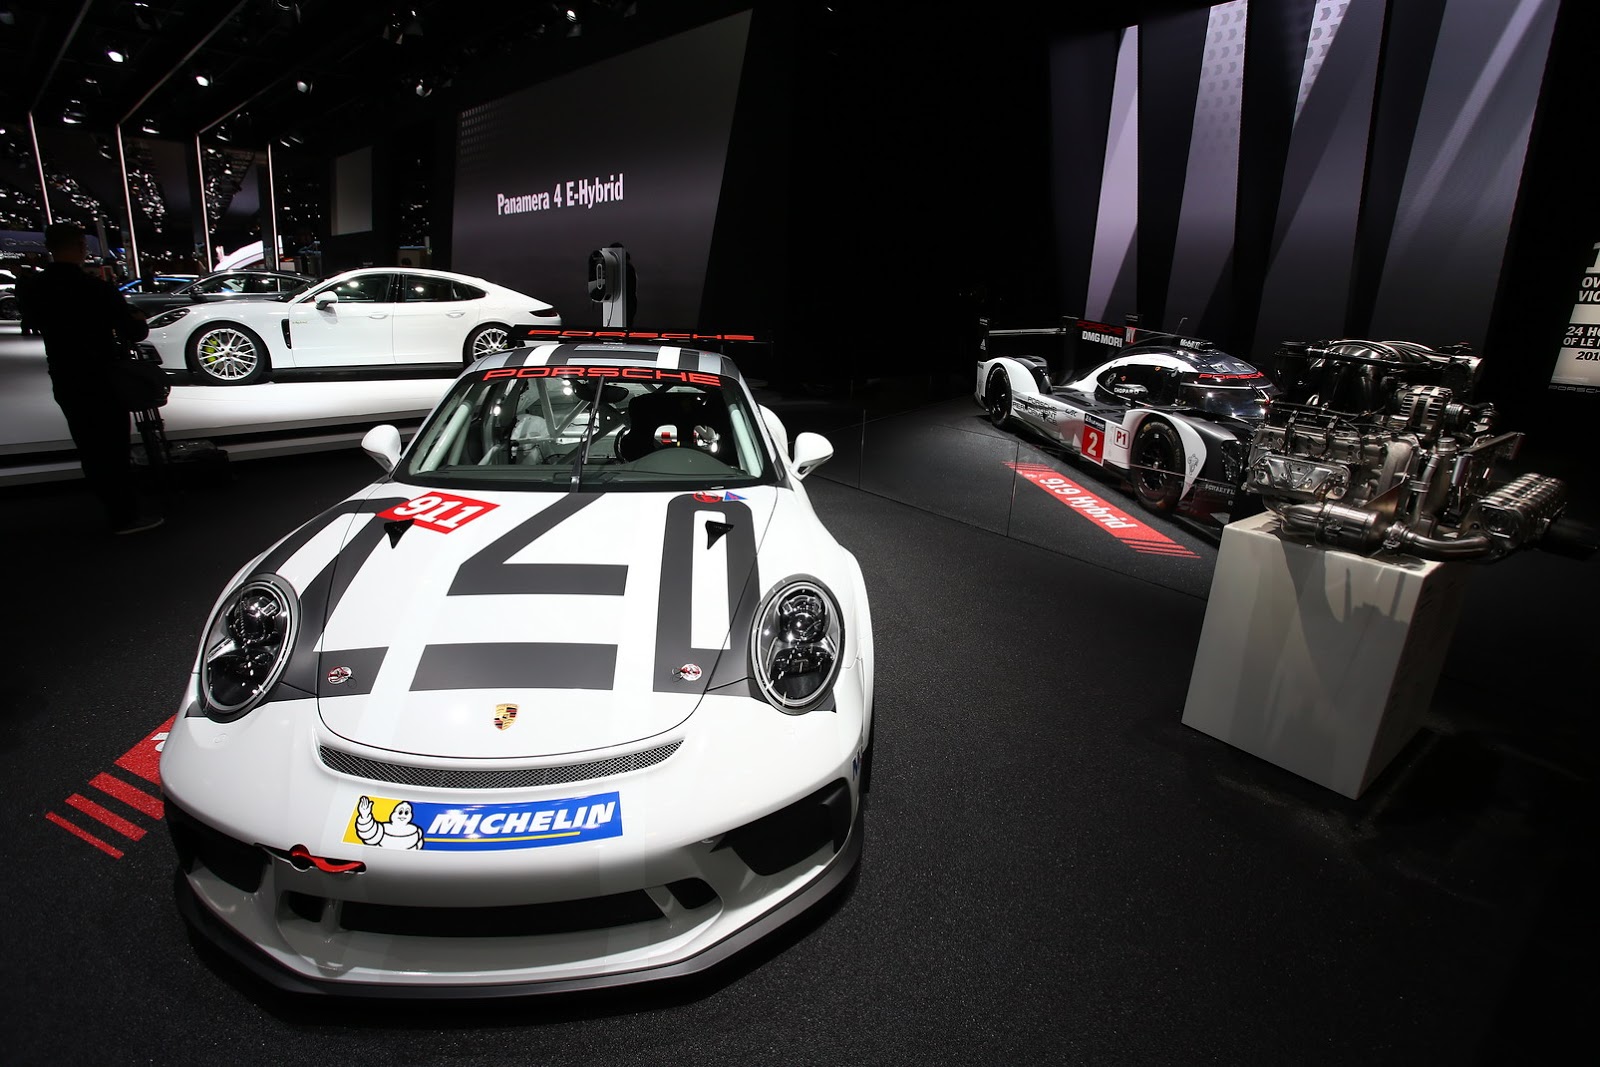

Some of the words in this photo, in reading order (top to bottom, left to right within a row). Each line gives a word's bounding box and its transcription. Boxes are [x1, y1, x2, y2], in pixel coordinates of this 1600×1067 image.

[497, 193, 550, 215] Panamera
[553, 183, 563, 208] 4
[566, 173, 624, 209] E-Hybrid
[527, 329, 755, 341] PORSCHE
[1081, 331, 1100, 343] DMG
[1100, 334, 1123, 348] MORI
[1565, 326, 1584, 336] 24
[1563, 337, 1579, 345] OF
[1580, 338, 1595, 346] LE
[483, 367, 721, 387] PORSCHE
[1087, 431, 1099, 457] 2
[1116, 431, 1127, 446] P1
[393, 496, 485, 529] 911
[1039, 478, 1081, 494] 919
[1066, 496, 1138, 528] Hybrid
[427, 802, 616, 836] MICHELIN
